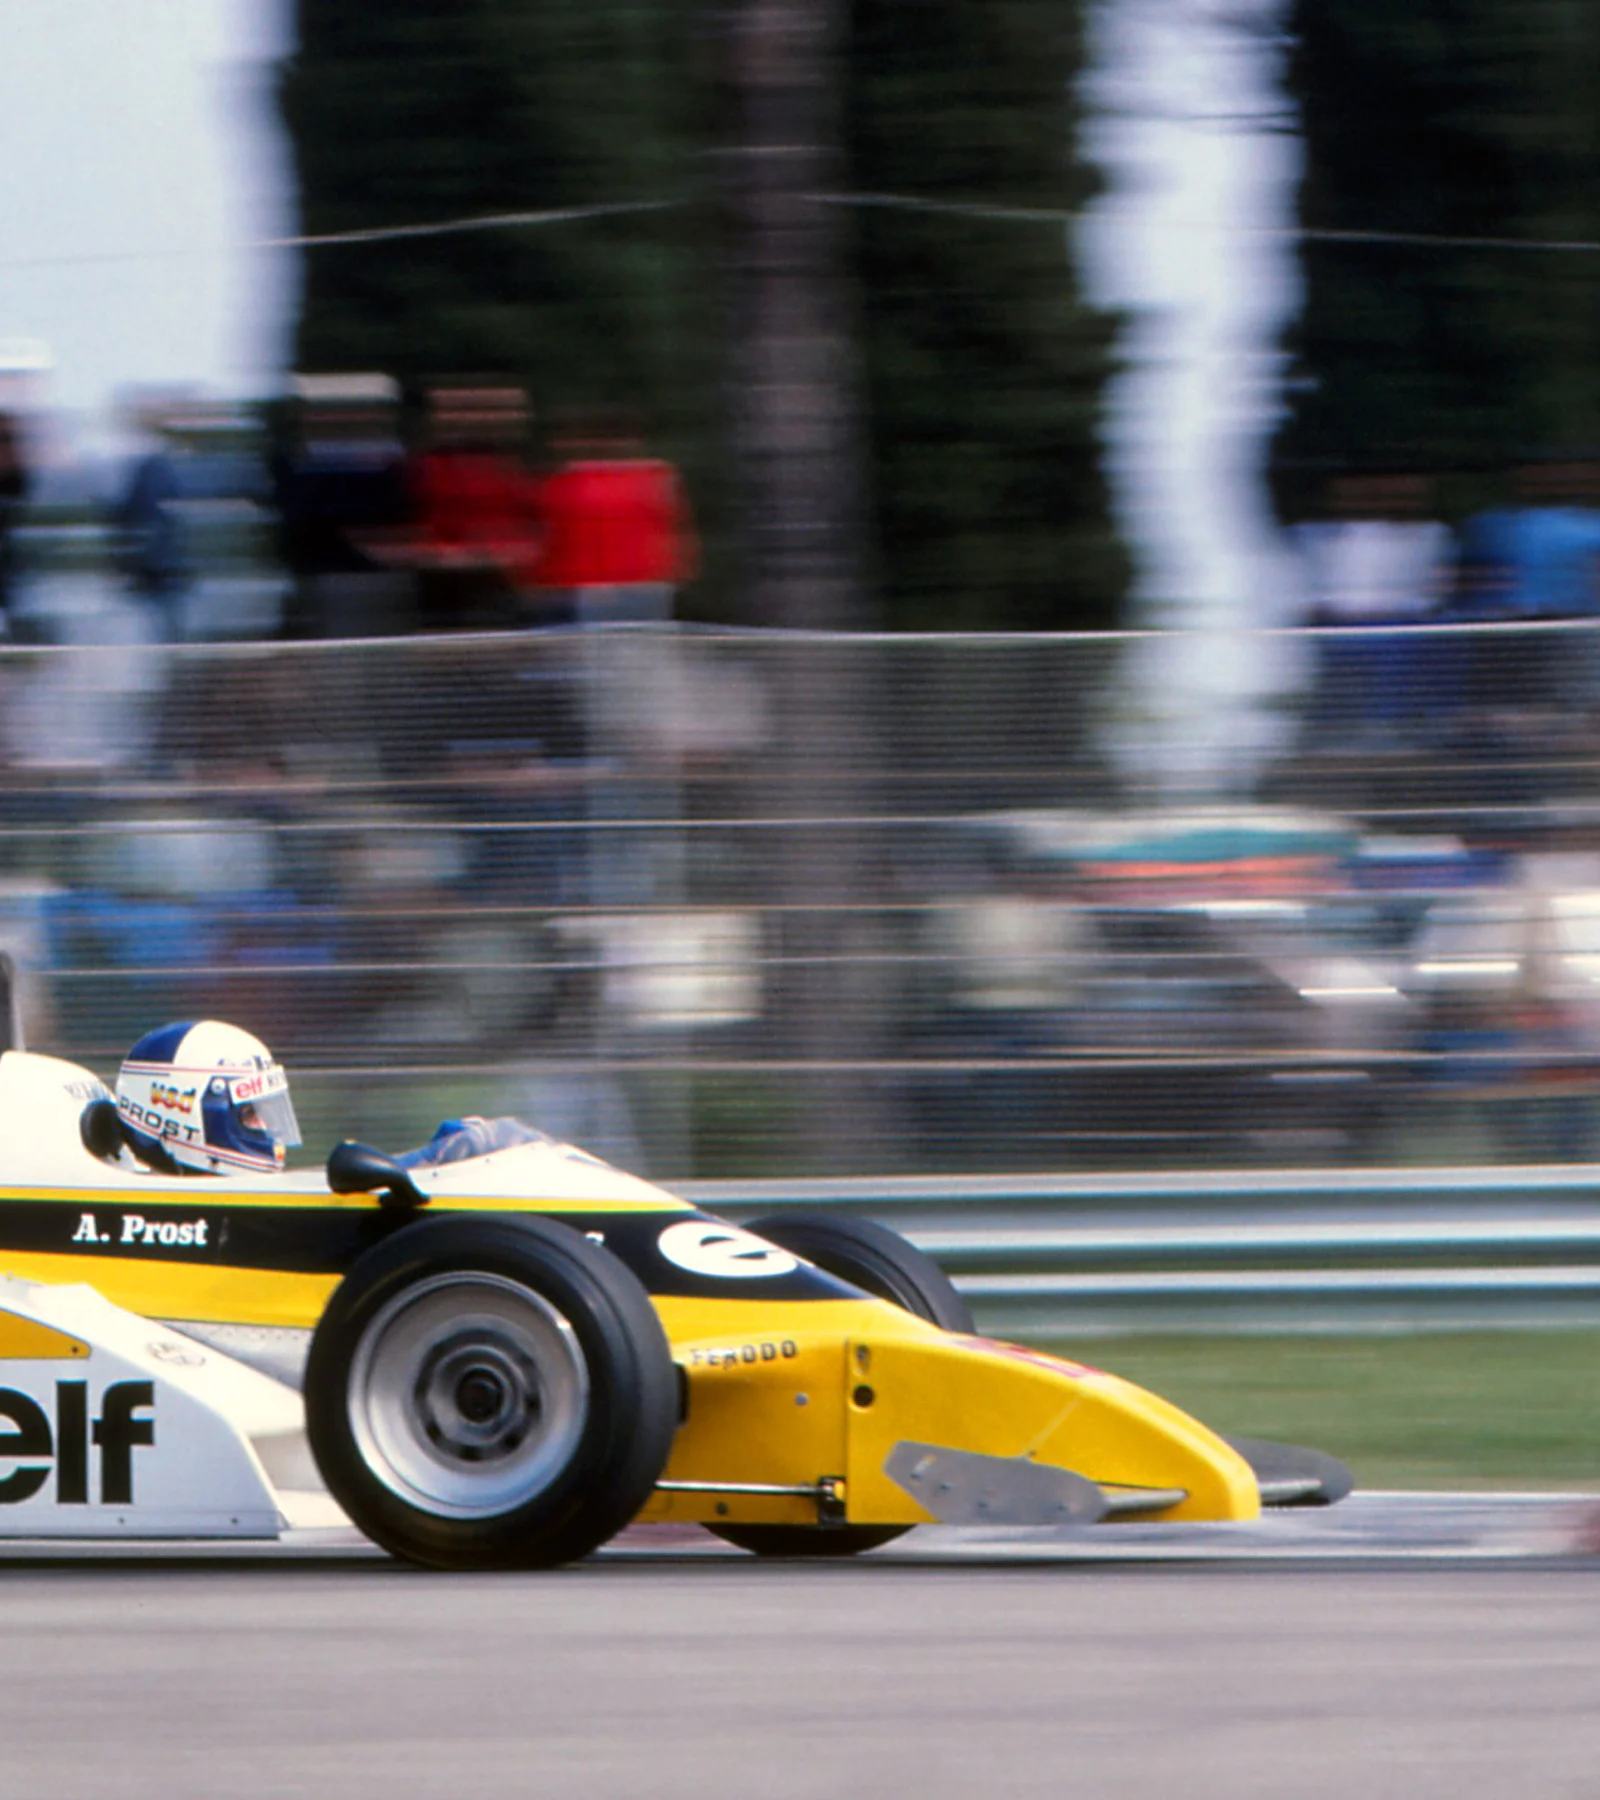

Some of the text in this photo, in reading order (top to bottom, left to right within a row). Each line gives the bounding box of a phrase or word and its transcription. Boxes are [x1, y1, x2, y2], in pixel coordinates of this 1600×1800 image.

[235, 1076, 264, 1099] elf
[118, 1095, 200, 1142] PROST
[73, 1214, 208, 1245] A. Prost
